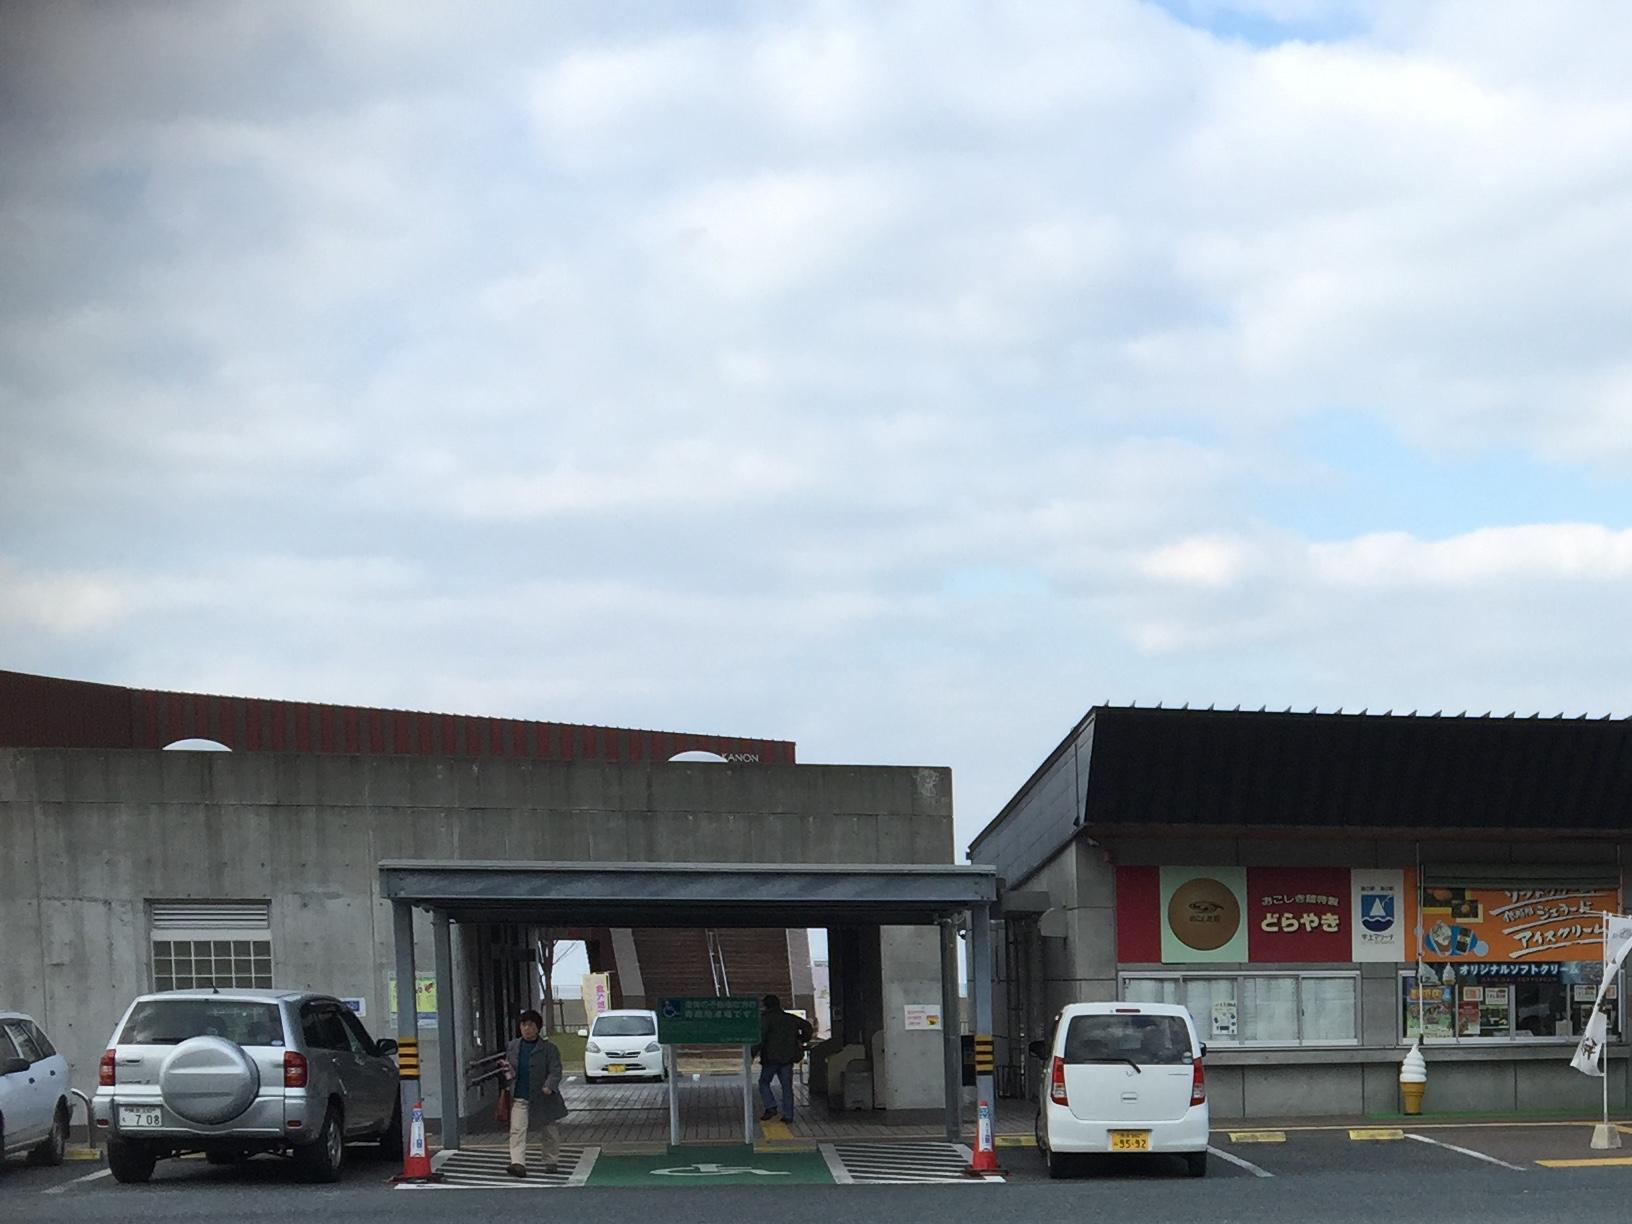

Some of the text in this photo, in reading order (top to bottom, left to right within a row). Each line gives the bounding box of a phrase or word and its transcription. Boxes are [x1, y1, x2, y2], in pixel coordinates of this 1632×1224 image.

[1261, 912, 1340, 932] どらやき
[1459, 964, 1579, 976] オリジナルソフトクリーム
